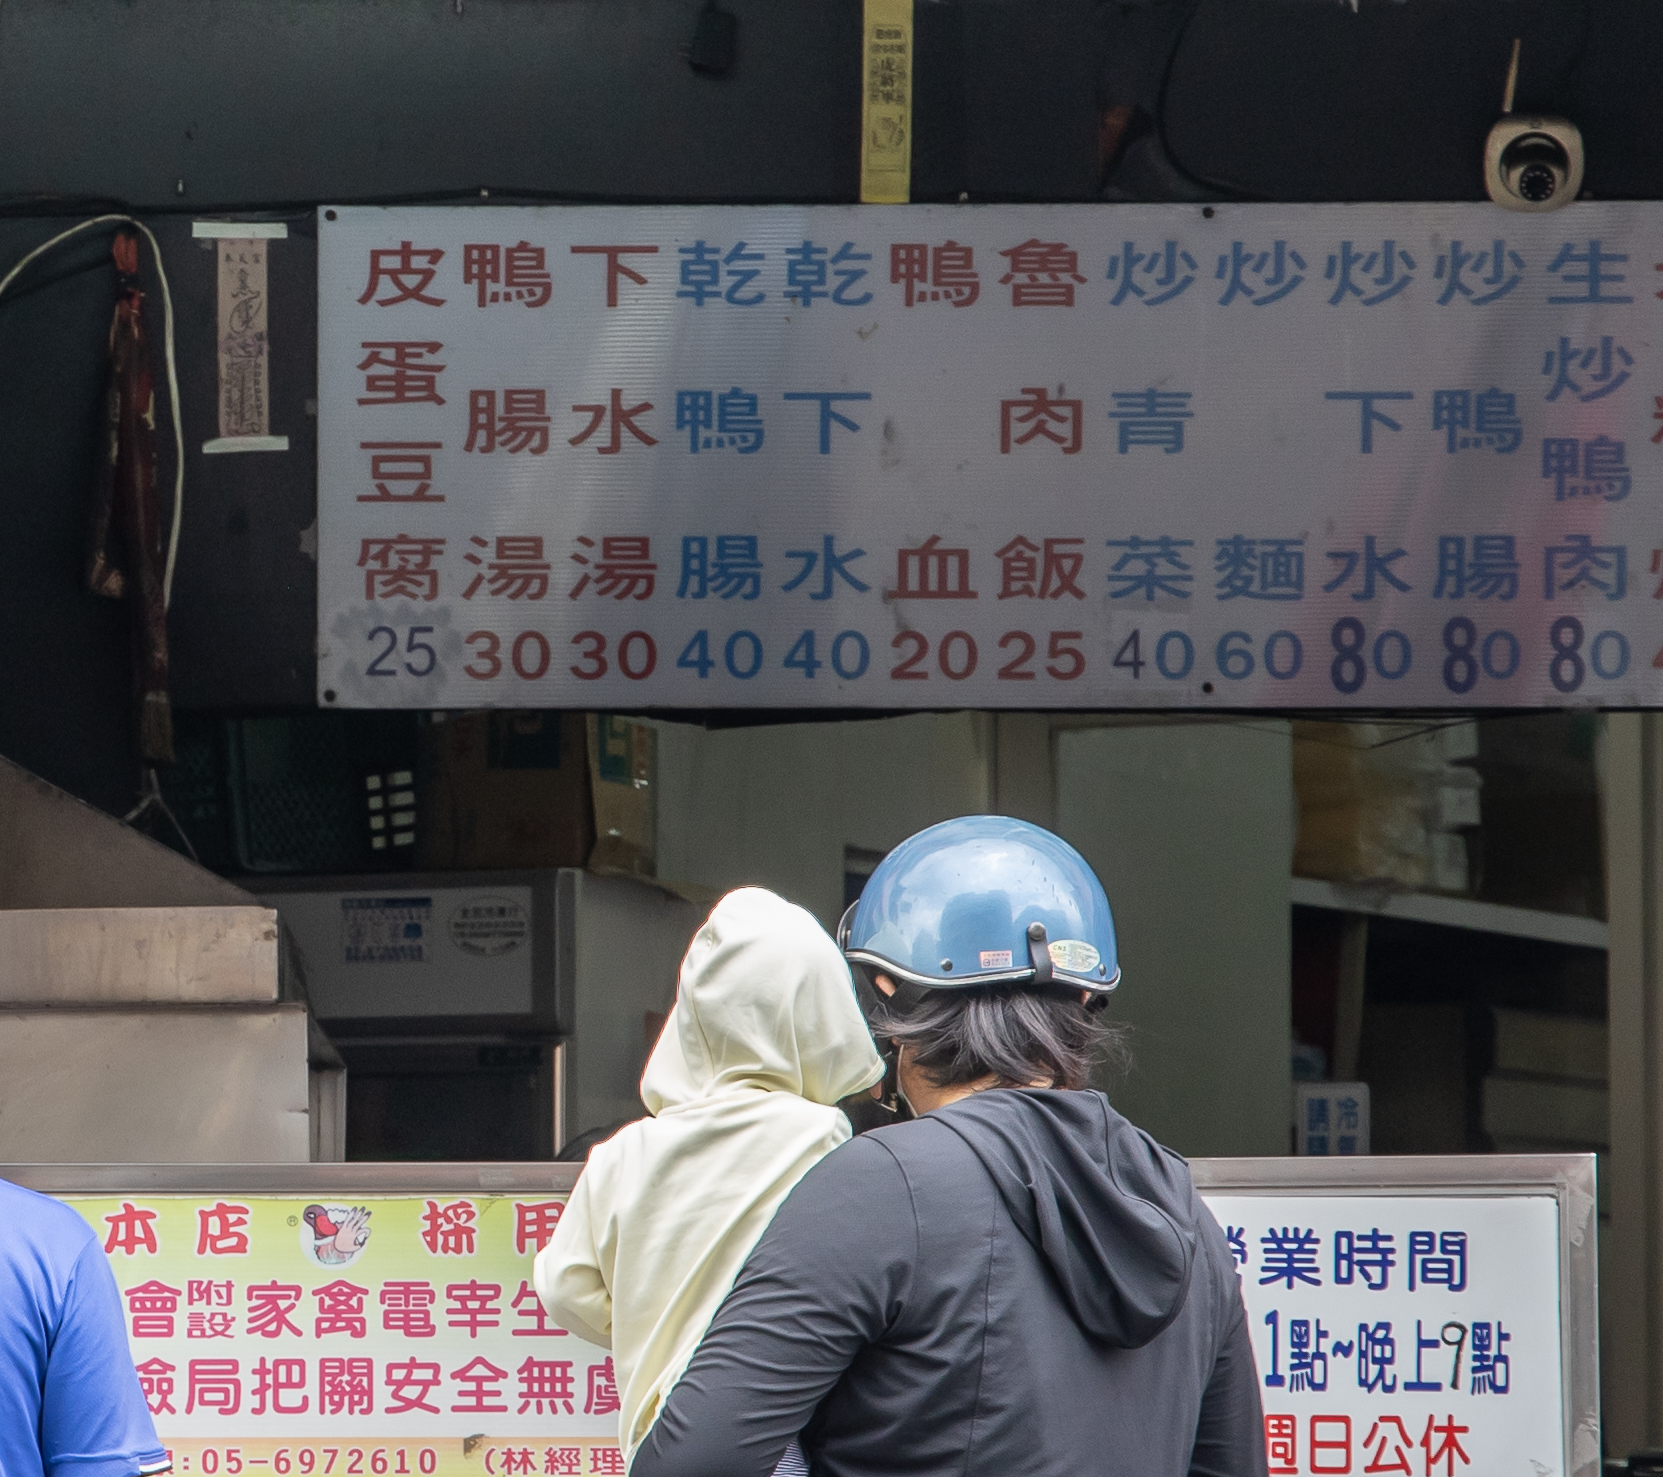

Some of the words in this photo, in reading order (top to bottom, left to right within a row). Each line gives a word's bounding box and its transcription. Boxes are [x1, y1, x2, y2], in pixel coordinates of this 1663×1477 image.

[357, 239, 446, 602] 皮蛋豆腐
[460, 239, 553, 602] 鴨腸湯
[568, 244, 660, 602] 下水湯
[676, 239, 766, 602] 乾鴨腸
[782, 239, 873, 602] 乾下水
[887, 239, 980, 602] 鴨血
[994, 237, 1088, 602] 魯肉飯
[1104, 239, 1197, 602] 炒青菜
[1212, 239, 1306, 602] 炒麵
[1323, 239, 1414, 602] 炒下水
[1431, 239, 1524, 602] 炒鴨腸
[1541, 239, 1636, 602] 生炒鴨肉
[364, 625, 436, 679] 25
[462, 628, 552, 680] 30
[568, 628, 658, 680] 30
[676, 628, 764, 680] 40
[783, 628, 871, 680] 40
[889, 628, 979, 680] 20
[996, 628, 1086, 680] 25
[1112, 628, 1196, 680] 40
[1216, 628, 1304, 680] 60
[1330, 616, 1414, 695] 80
[1441, 616, 1521, 695] 80
[1548, 616, 1632, 695] 80
[104, 1202, 250, 1255] 本店
